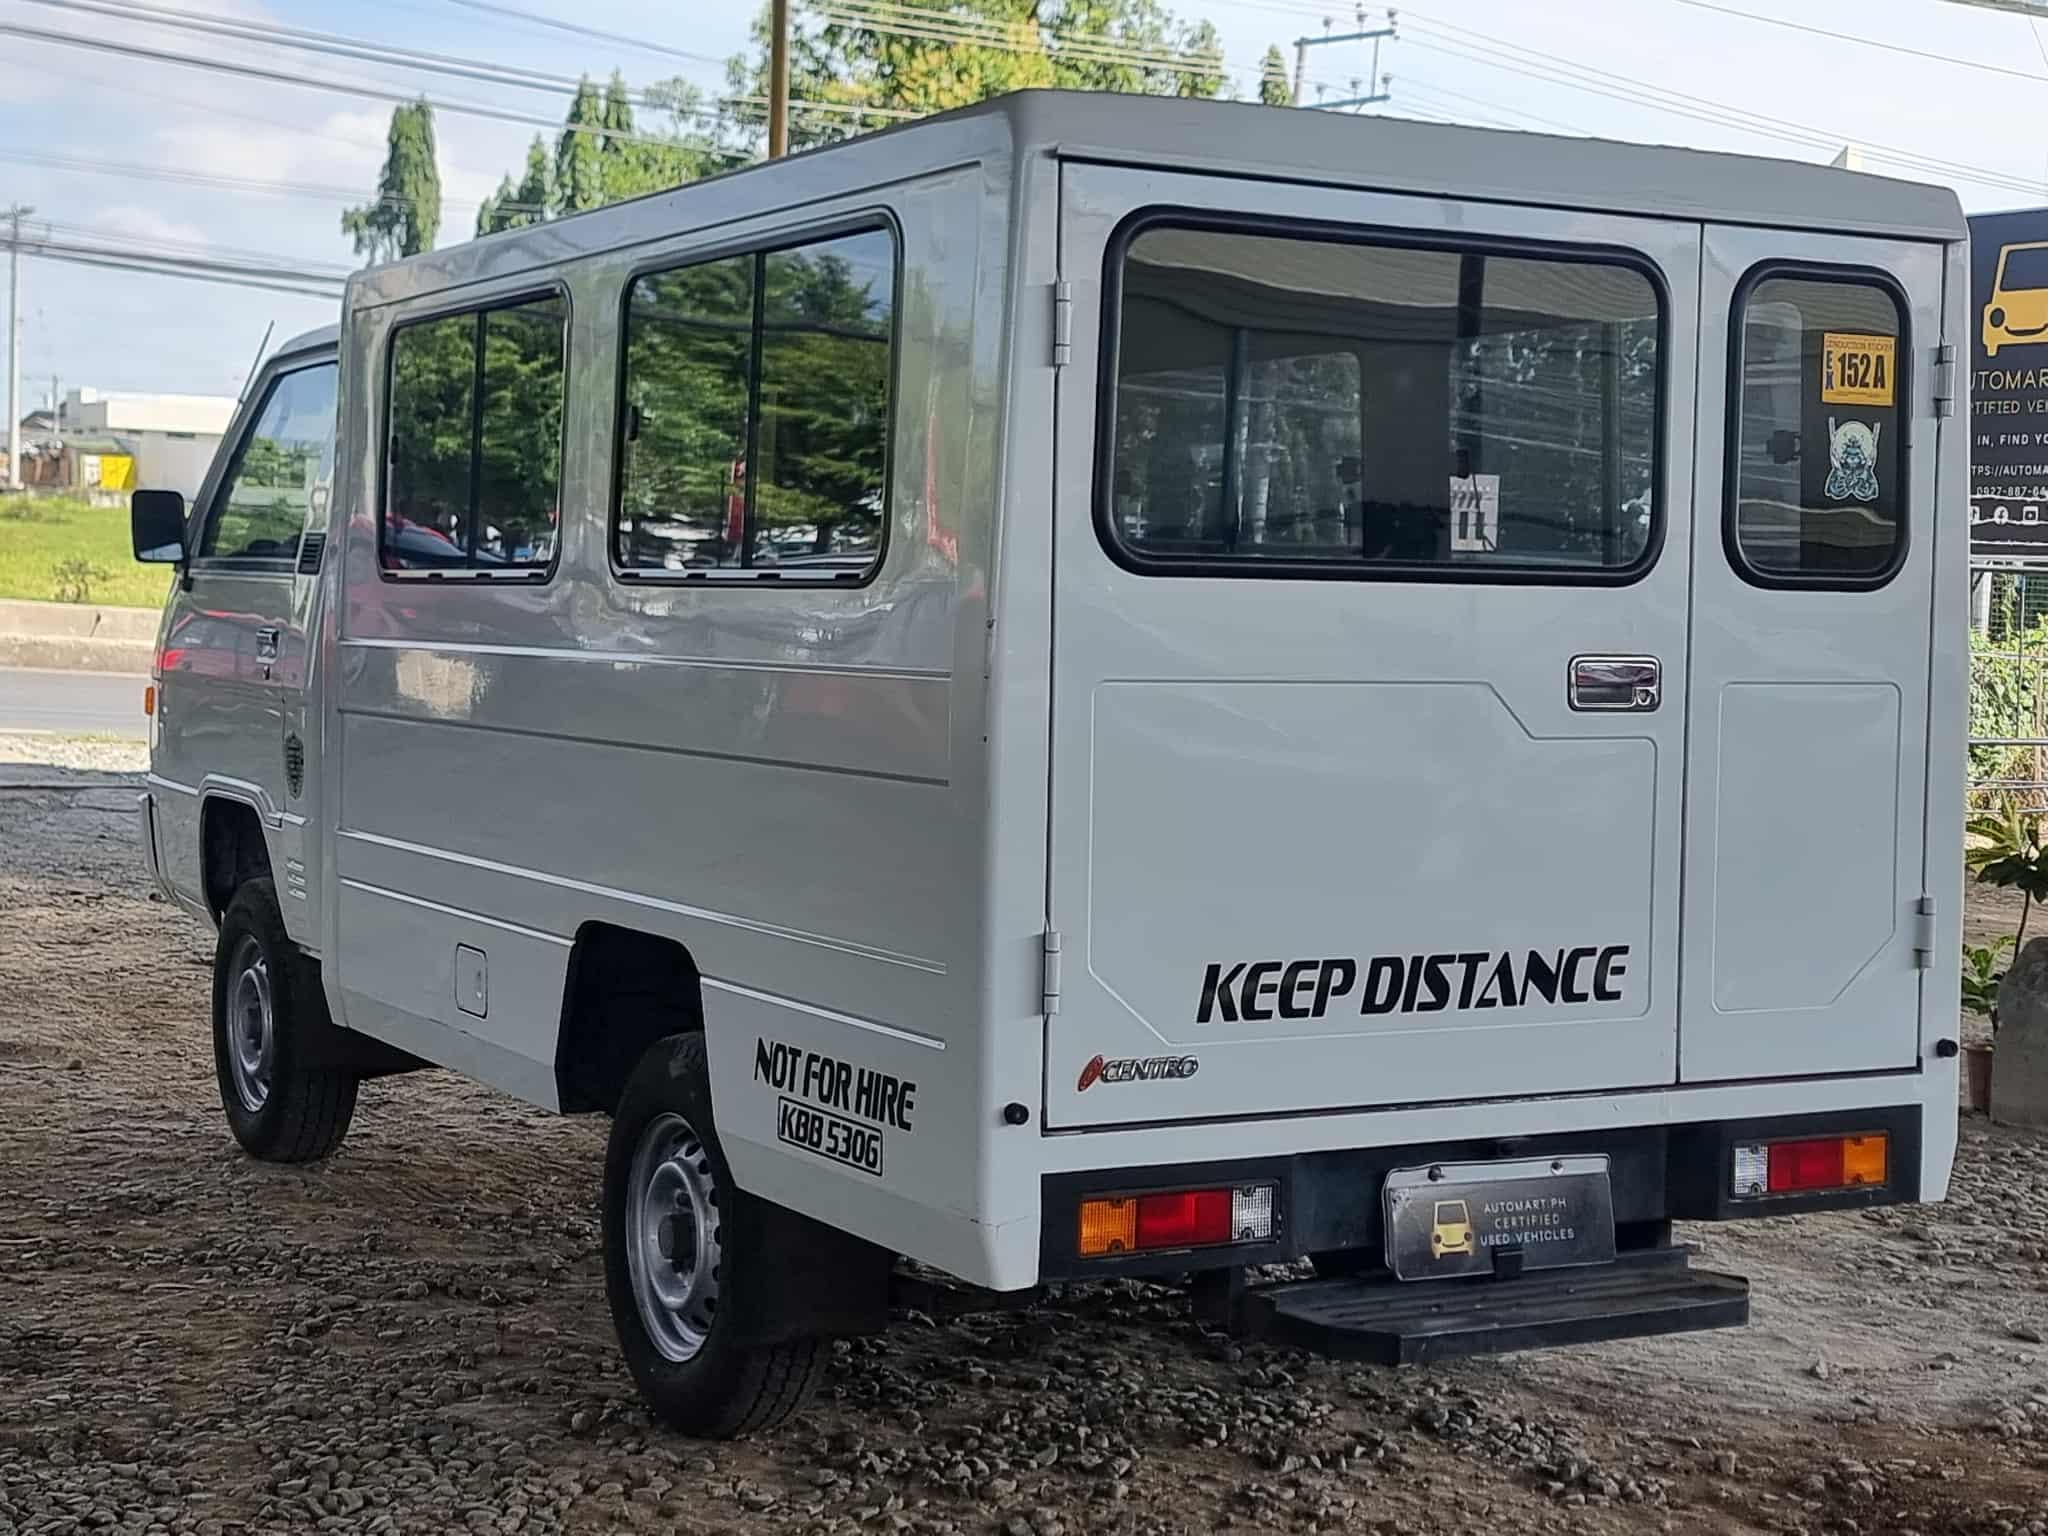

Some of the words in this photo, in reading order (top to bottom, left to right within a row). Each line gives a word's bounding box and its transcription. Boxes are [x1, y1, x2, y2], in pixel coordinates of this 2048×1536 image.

[1971, 400, 2021, 415] TIFIED
[2027, 399, 2048, 413] VE
[1977, 434, 1994, 448] IN,
[2000, 434, 2029, 446] FIND
[1197, 959, 1356, 1023] KEEP
[1360, 945, 1630, 1015] DISTANCE
[1101, 1055, 1198, 1083] CENTRO
[754, 1036, 802, 1092] NOT
[803, 1053, 852, 1110] FOR
[855, 1068, 916, 1131] HIRE
[781, 1103, 823, 1148] KBB
[826, 1119, 880, 1169] 5306
[1494, 1213, 1560, 1230] CERTIFIED
[1480, 1233, 1511, 1248] USED
[1514, 1227, 1575, 1244] VEHICLES
